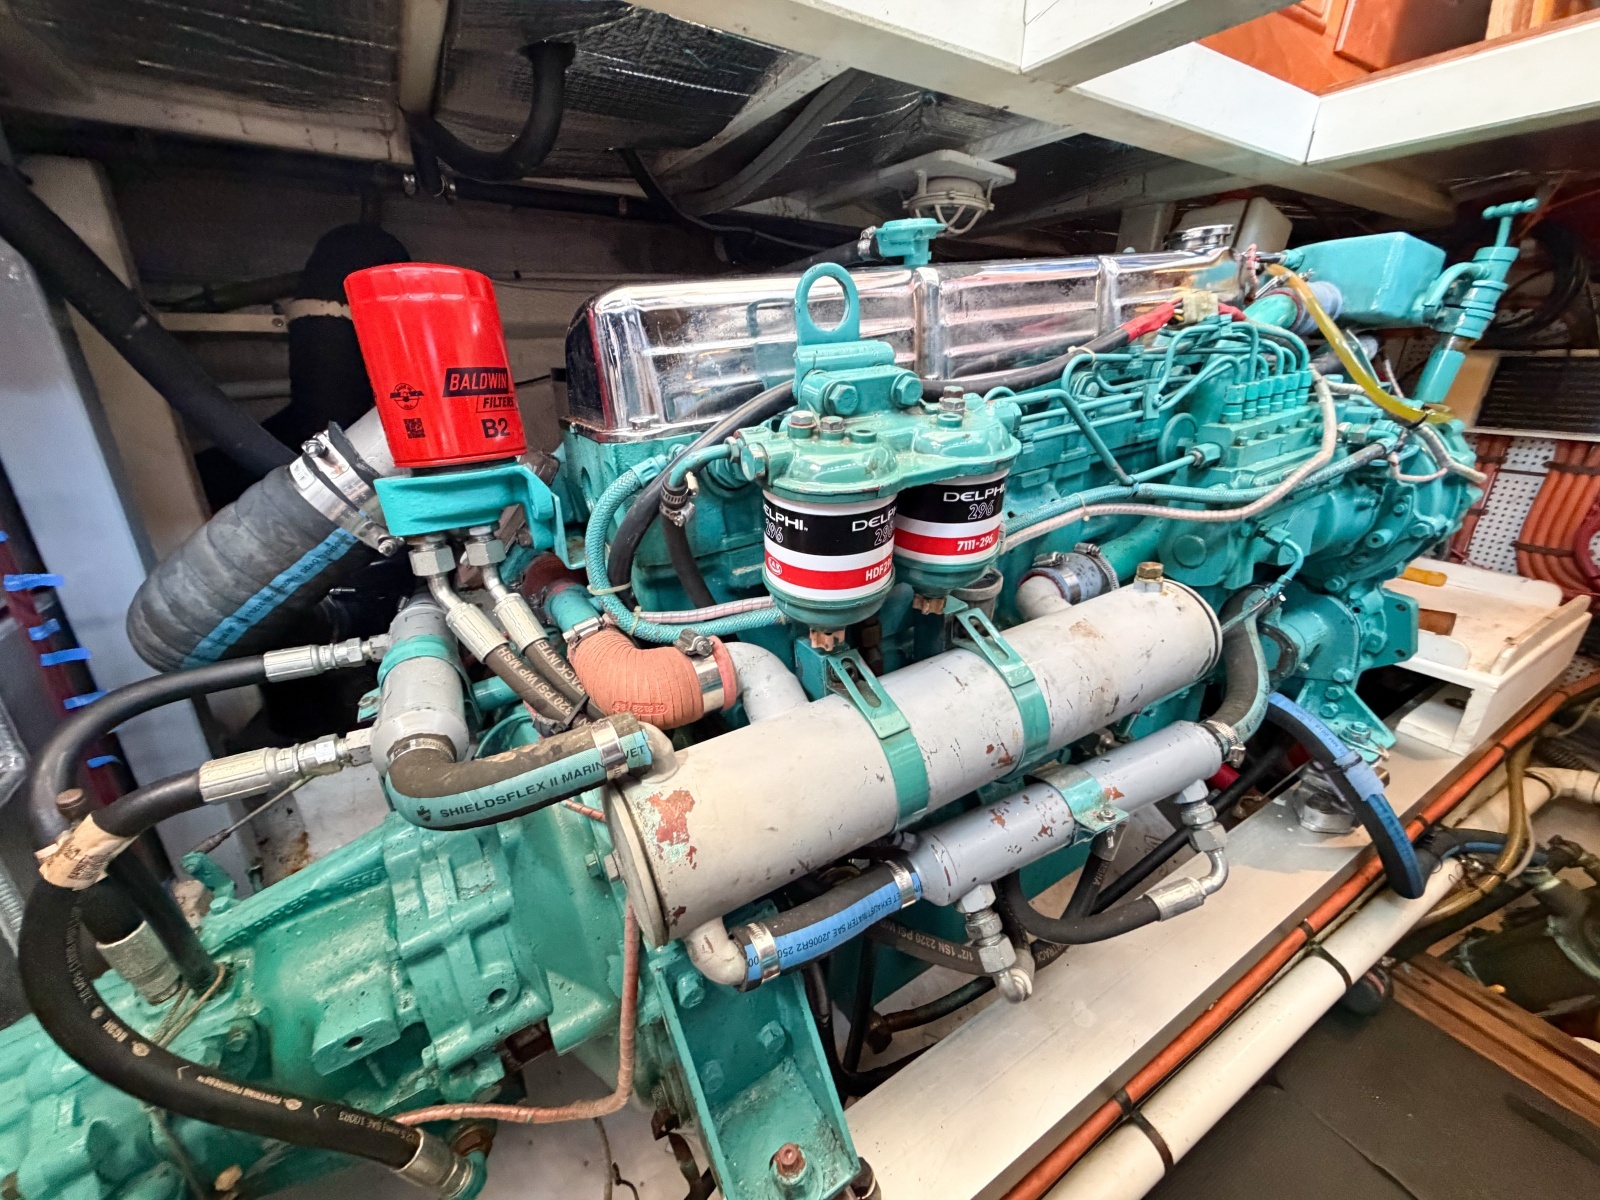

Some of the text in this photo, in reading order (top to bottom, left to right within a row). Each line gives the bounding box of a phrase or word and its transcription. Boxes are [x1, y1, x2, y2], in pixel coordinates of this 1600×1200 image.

[449, 372, 508, 391] BALDWIN
[482, 396, 514, 409] FILTERS
[481, 417, 510, 438] B2
[763, 503, 804, 531] ELPHI
[968, 499, 995, 520] 296
[957, 534, 994, 551] 7111-296
[495, 645, 574, 716] 320 PSI WP MSH
[439, 781, 546, 819] SHIELDSFLEX
[550, 777, 560, 788] II
[562, 760, 606, 786] MARIN
[892, 891, 902, 903] ET
[831, 923, 847, 938] SAE
[915, 932, 937, 949] 2320
[794, 930, 832, 952] J2006R2
